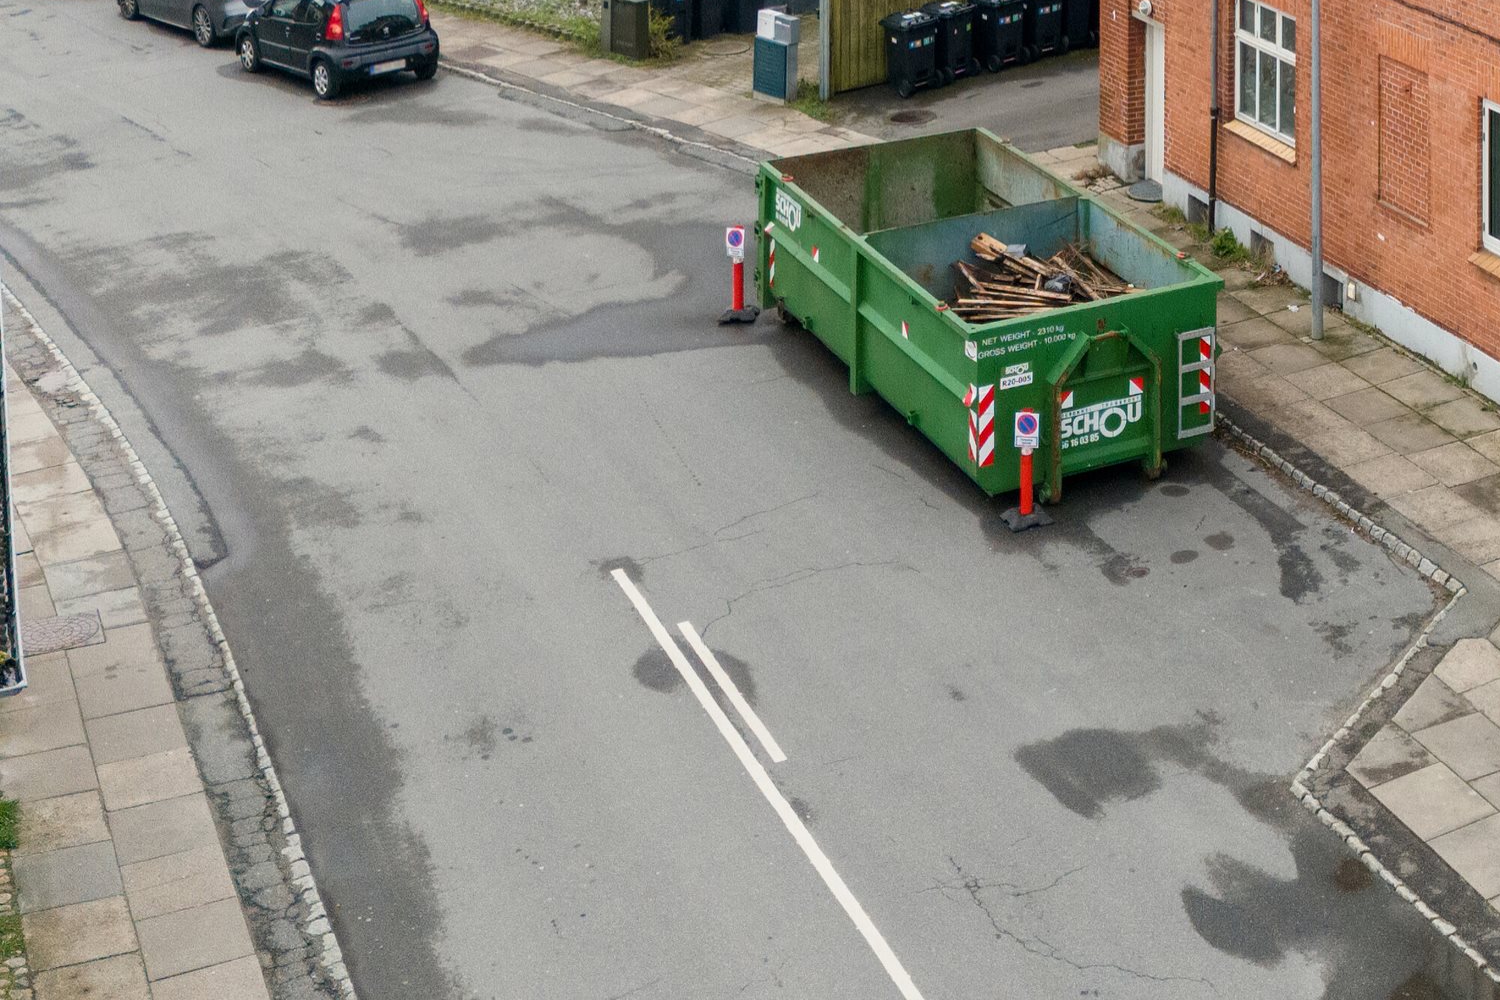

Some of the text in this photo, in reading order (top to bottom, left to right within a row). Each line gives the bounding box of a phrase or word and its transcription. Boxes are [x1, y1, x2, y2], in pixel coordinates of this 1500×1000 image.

[978, 348, 1006, 359] GROSS
[1008, 340, 1038, 352] WEIGHT
[1068, 332, 1076, 340] kg
[982, 337, 997, 346] NET
[1000, 330, 1031, 343] WEIGHT
[1037, 327, 1054, 336] 2310
[1056, 325, 1064, 333] kg
[1003, 376, 1031, 387] R20-005
[1061, 402, 1142, 438] SCHOU
[1090, 432, 1099, 442] 85
